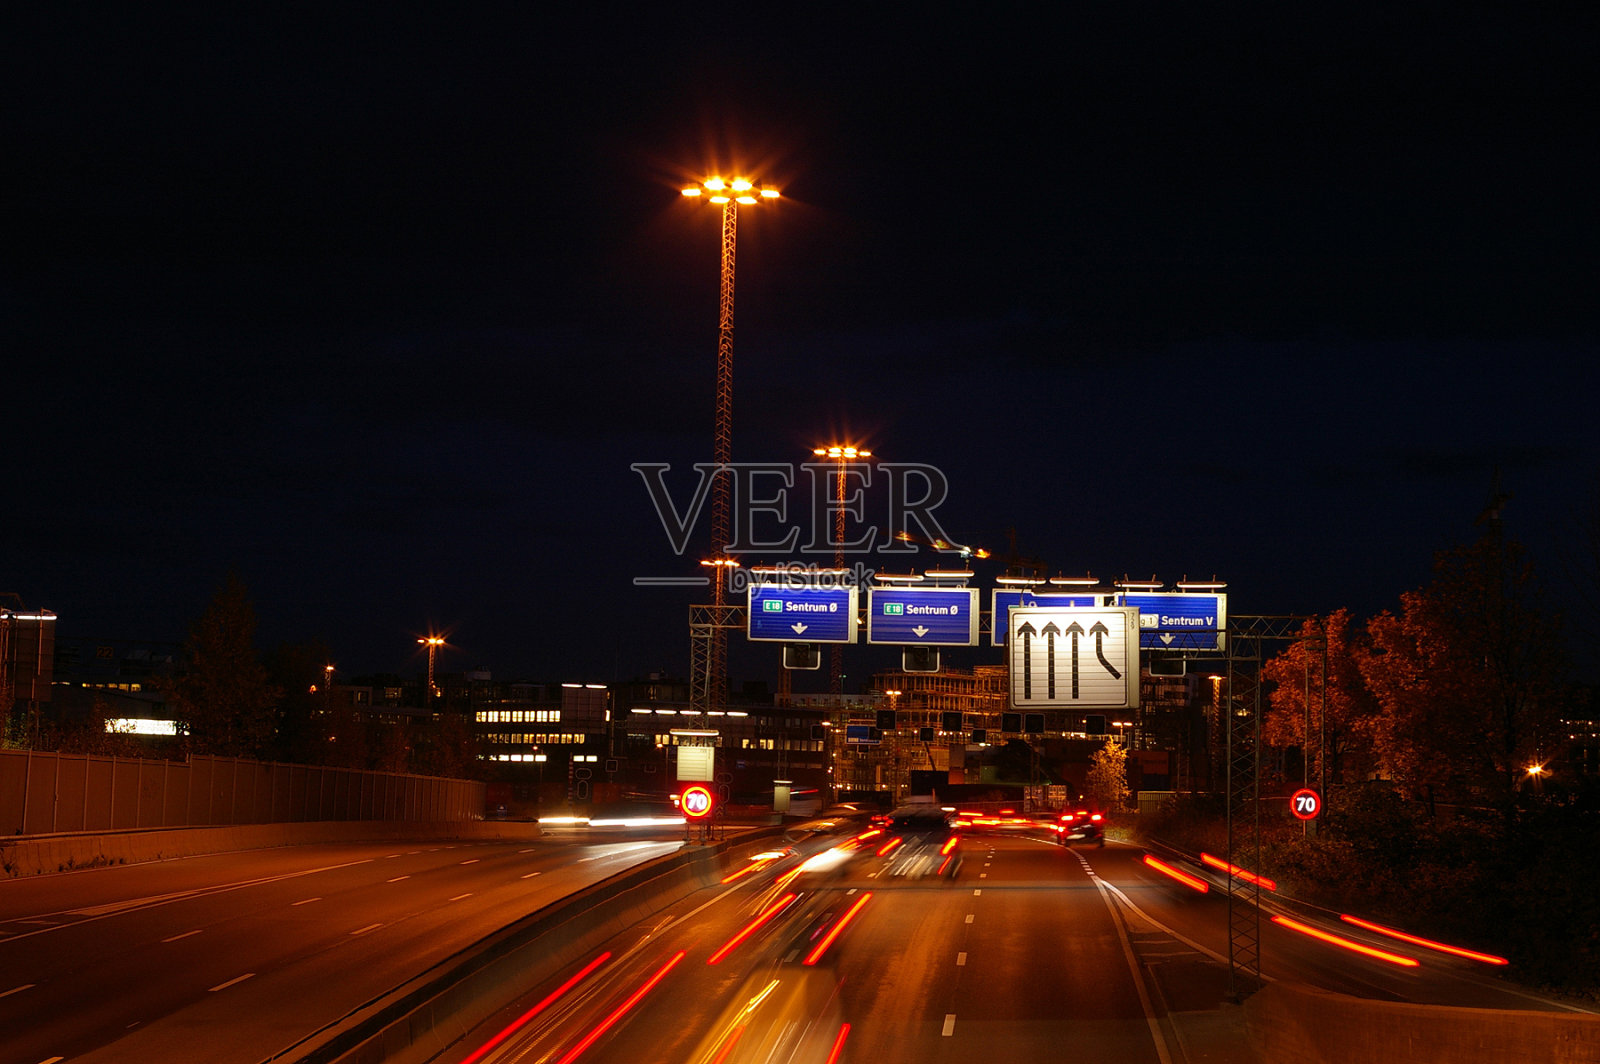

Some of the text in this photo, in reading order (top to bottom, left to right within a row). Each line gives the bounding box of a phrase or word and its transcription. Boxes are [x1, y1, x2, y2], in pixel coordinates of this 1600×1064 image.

[772, 602, 780, 610] 18
[786, 601, 827, 612] Sentrum
[829, 602, 837, 612] Ø
[893, 605, 901, 613] 18
[906, 604, 949, 615] Sentrum
[950, 605, 958, 615] Ø
[1161, 615, 1204, 626] Sentrum
[1206, 616, 1213, 626] V
[687, 793, 707, 809] 70
[1296, 796, 1316, 812] 70
